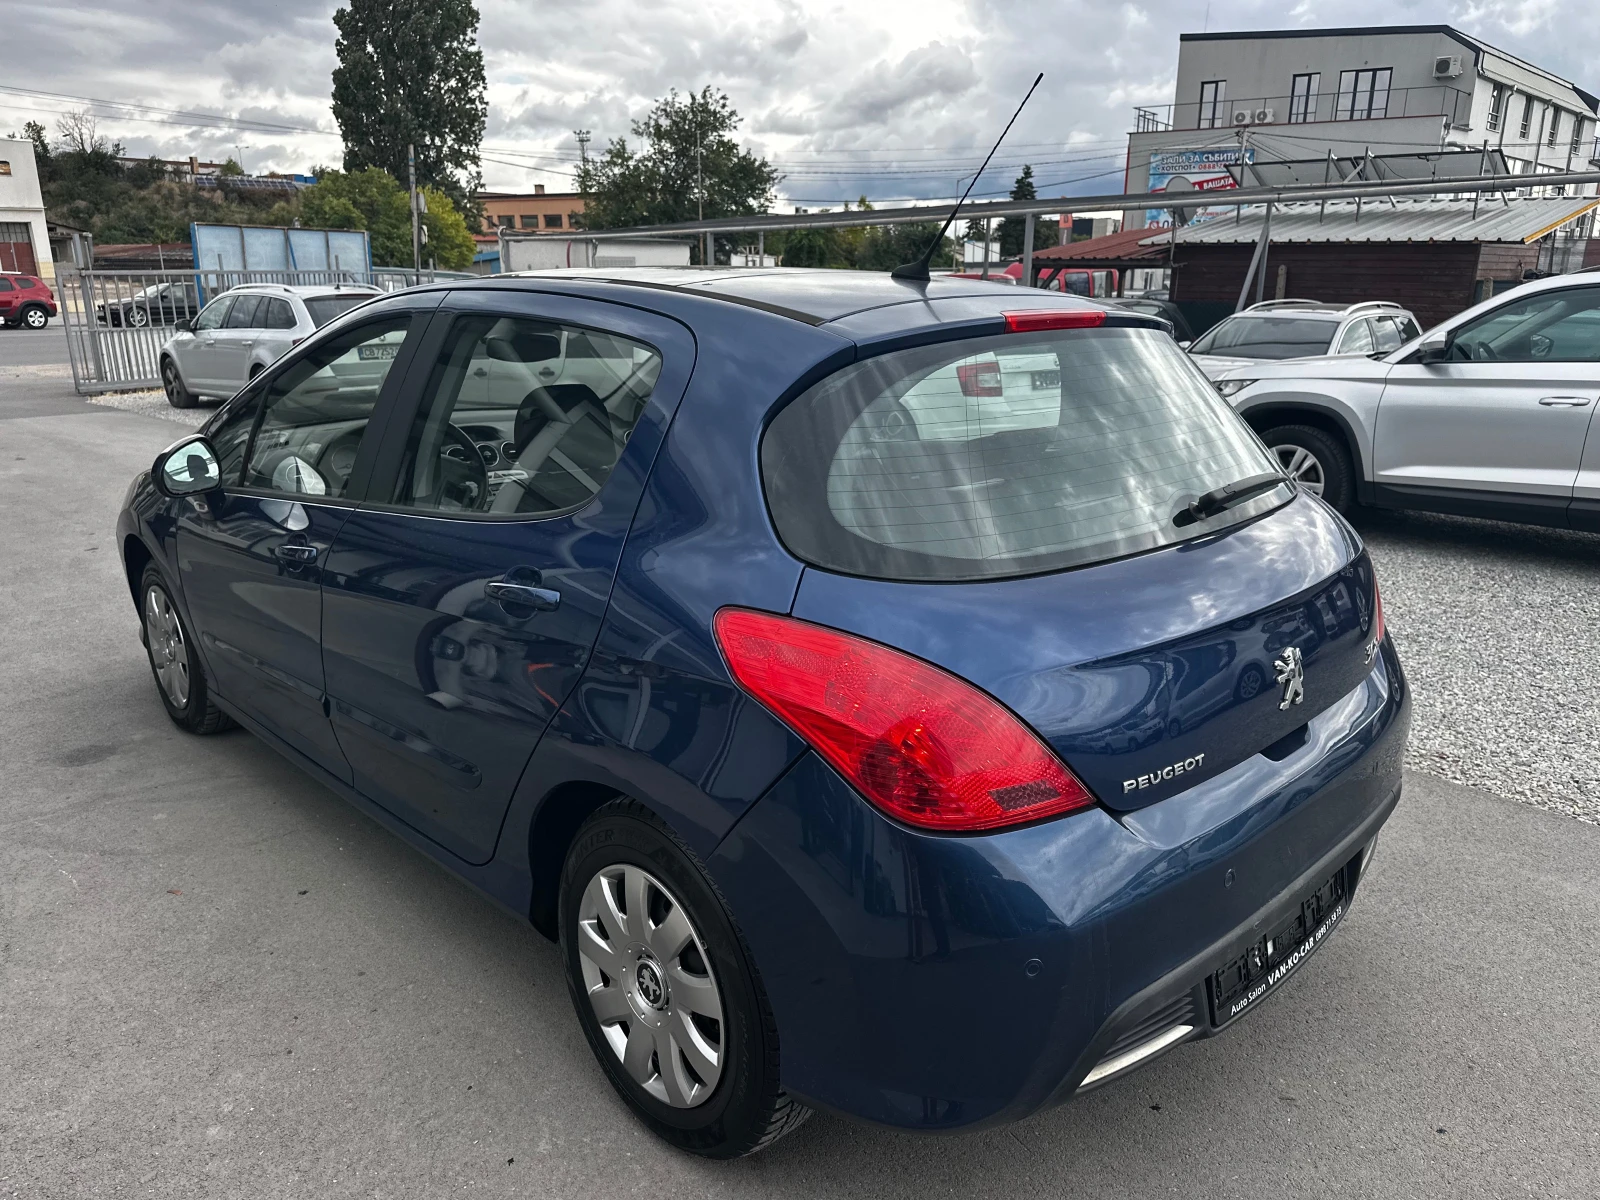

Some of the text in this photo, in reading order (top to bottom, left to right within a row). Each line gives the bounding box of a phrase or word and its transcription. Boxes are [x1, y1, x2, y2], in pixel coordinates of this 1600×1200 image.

[1189, 154, 1200, 163] ЗА
[1203, 152, 1239, 161] СЪБИТИ
[1122, 753, 1205, 794] PEUGEOT
[1230, 998, 1248, 1016] Auto
[1248, 983, 1266, 1002] Salon
[1267, 936, 1315, 985] VAN-KO-CAR
